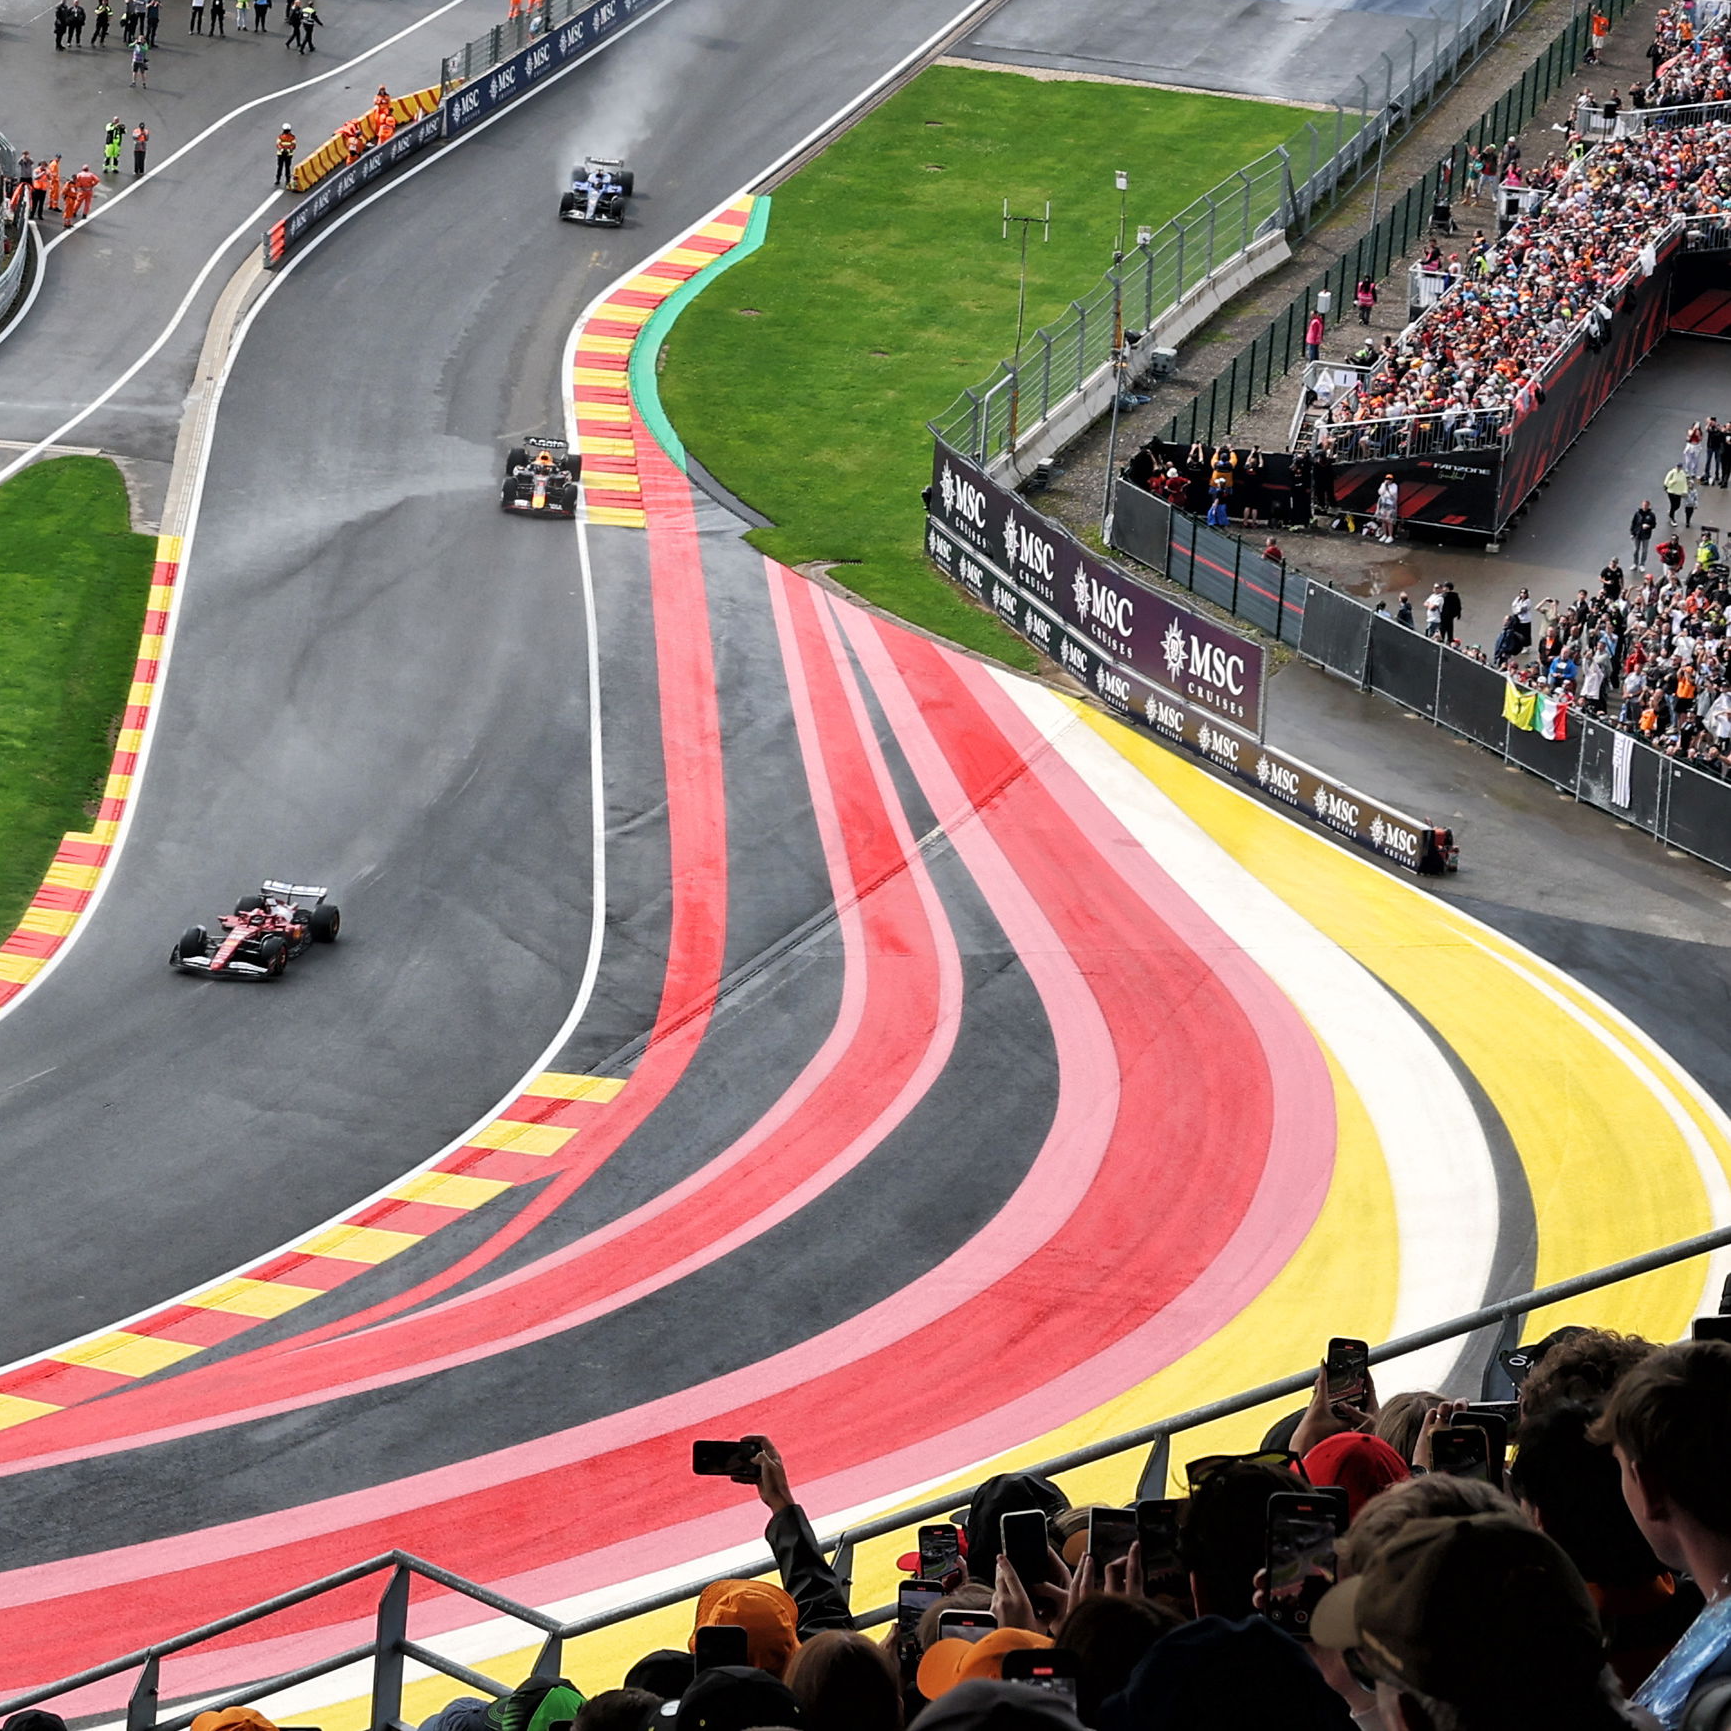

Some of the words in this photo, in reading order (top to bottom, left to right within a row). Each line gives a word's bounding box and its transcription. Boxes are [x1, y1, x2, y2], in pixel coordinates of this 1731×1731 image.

[599, 0, 616, 23] MSC
[568, 22, 584, 46] MSC
[533, 43, 551, 68] MSC
[498, 66, 516, 93] MSC
[461, 89, 480, 116] MSC
[955, 475, 987, 528] MSC
[955, 517, 987, 549] CRUISES
[936, 536, 952, 562] MSC
[1019, 526, 1055, 581] MSC
[967, 562, 983, 589] MSC
[1020, 570, 1054, 602] CRUISES
[1000, 589, 1017, 616] MSC
[1090, 579, 1133, 637] MSC
[1033, 615, 1051, 643] MSC
[1091, 625, 1133, 659] CRUISES
[1070, 644, 1087, 673] MSC
[1189, 636, 1245, 696] MSC
[1105, 672, 1130, 702] MSC
[1188, 682, 1245, 718] CRUISES
[1158, 702, 1184, 731] MSC
[1211, 730, 1239, 762] MSC
[1270, 763, 1299, 795] MSC
[1328, 794, 1359, 827] MSC
[1386, 823, 1417, 856] MSC
